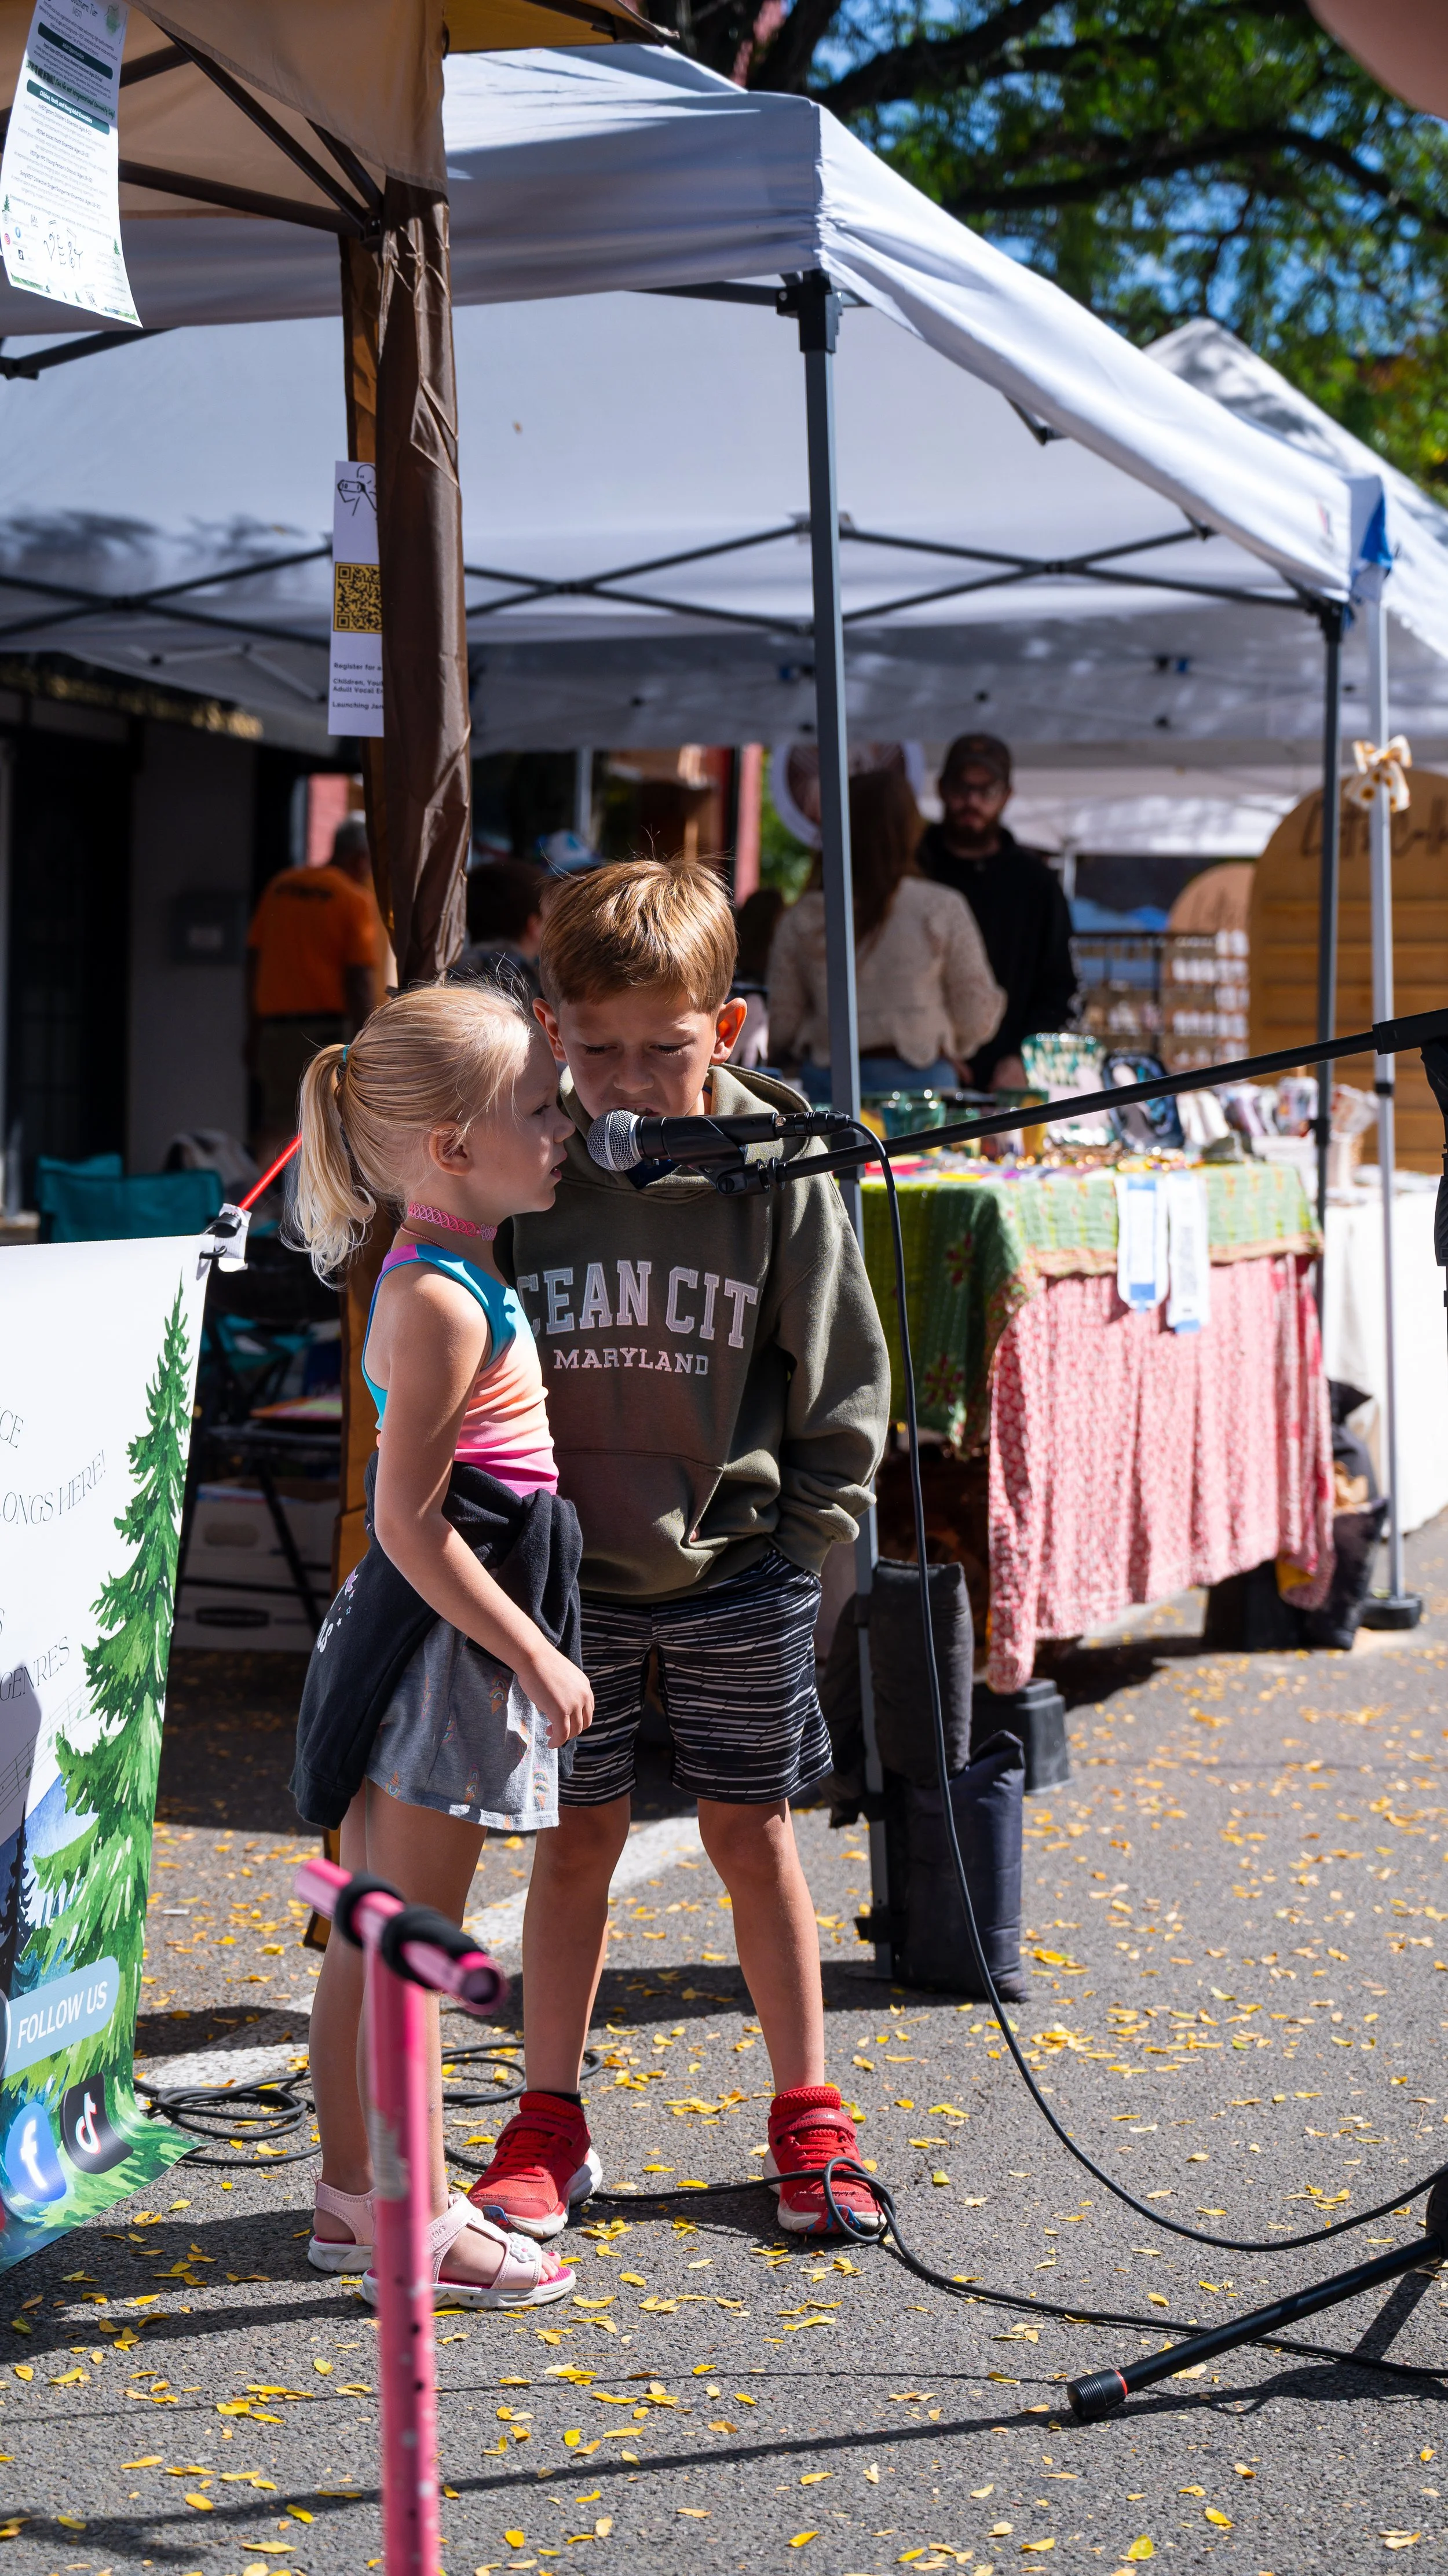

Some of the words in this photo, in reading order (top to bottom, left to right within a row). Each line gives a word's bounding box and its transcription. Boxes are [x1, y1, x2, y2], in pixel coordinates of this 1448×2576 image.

[39, 89, 51, 101] Children,
[50, 96, 58, 106] Youth,
[78, 111, 92, 123] Ensembles
[332, 701, 370, 710] Launching
[517, 1259, 652, 1337] CEAN
[666, 1265, 759, 1349] CIT
[554, 1347, 710, 1375] MARYLAND
[0, 1409, 24, 1449] CE
[0, 1491, 54, 1526] ONGS
[58, 1449, 107, 1516] HERE!
[0, 1636, 70, 1702] GENRES
[17, 1990, 85, 2049] FOLLOW
[87, 1981, 108, 2015] US
[799, 2113, 836, 2121] ARMOUR
